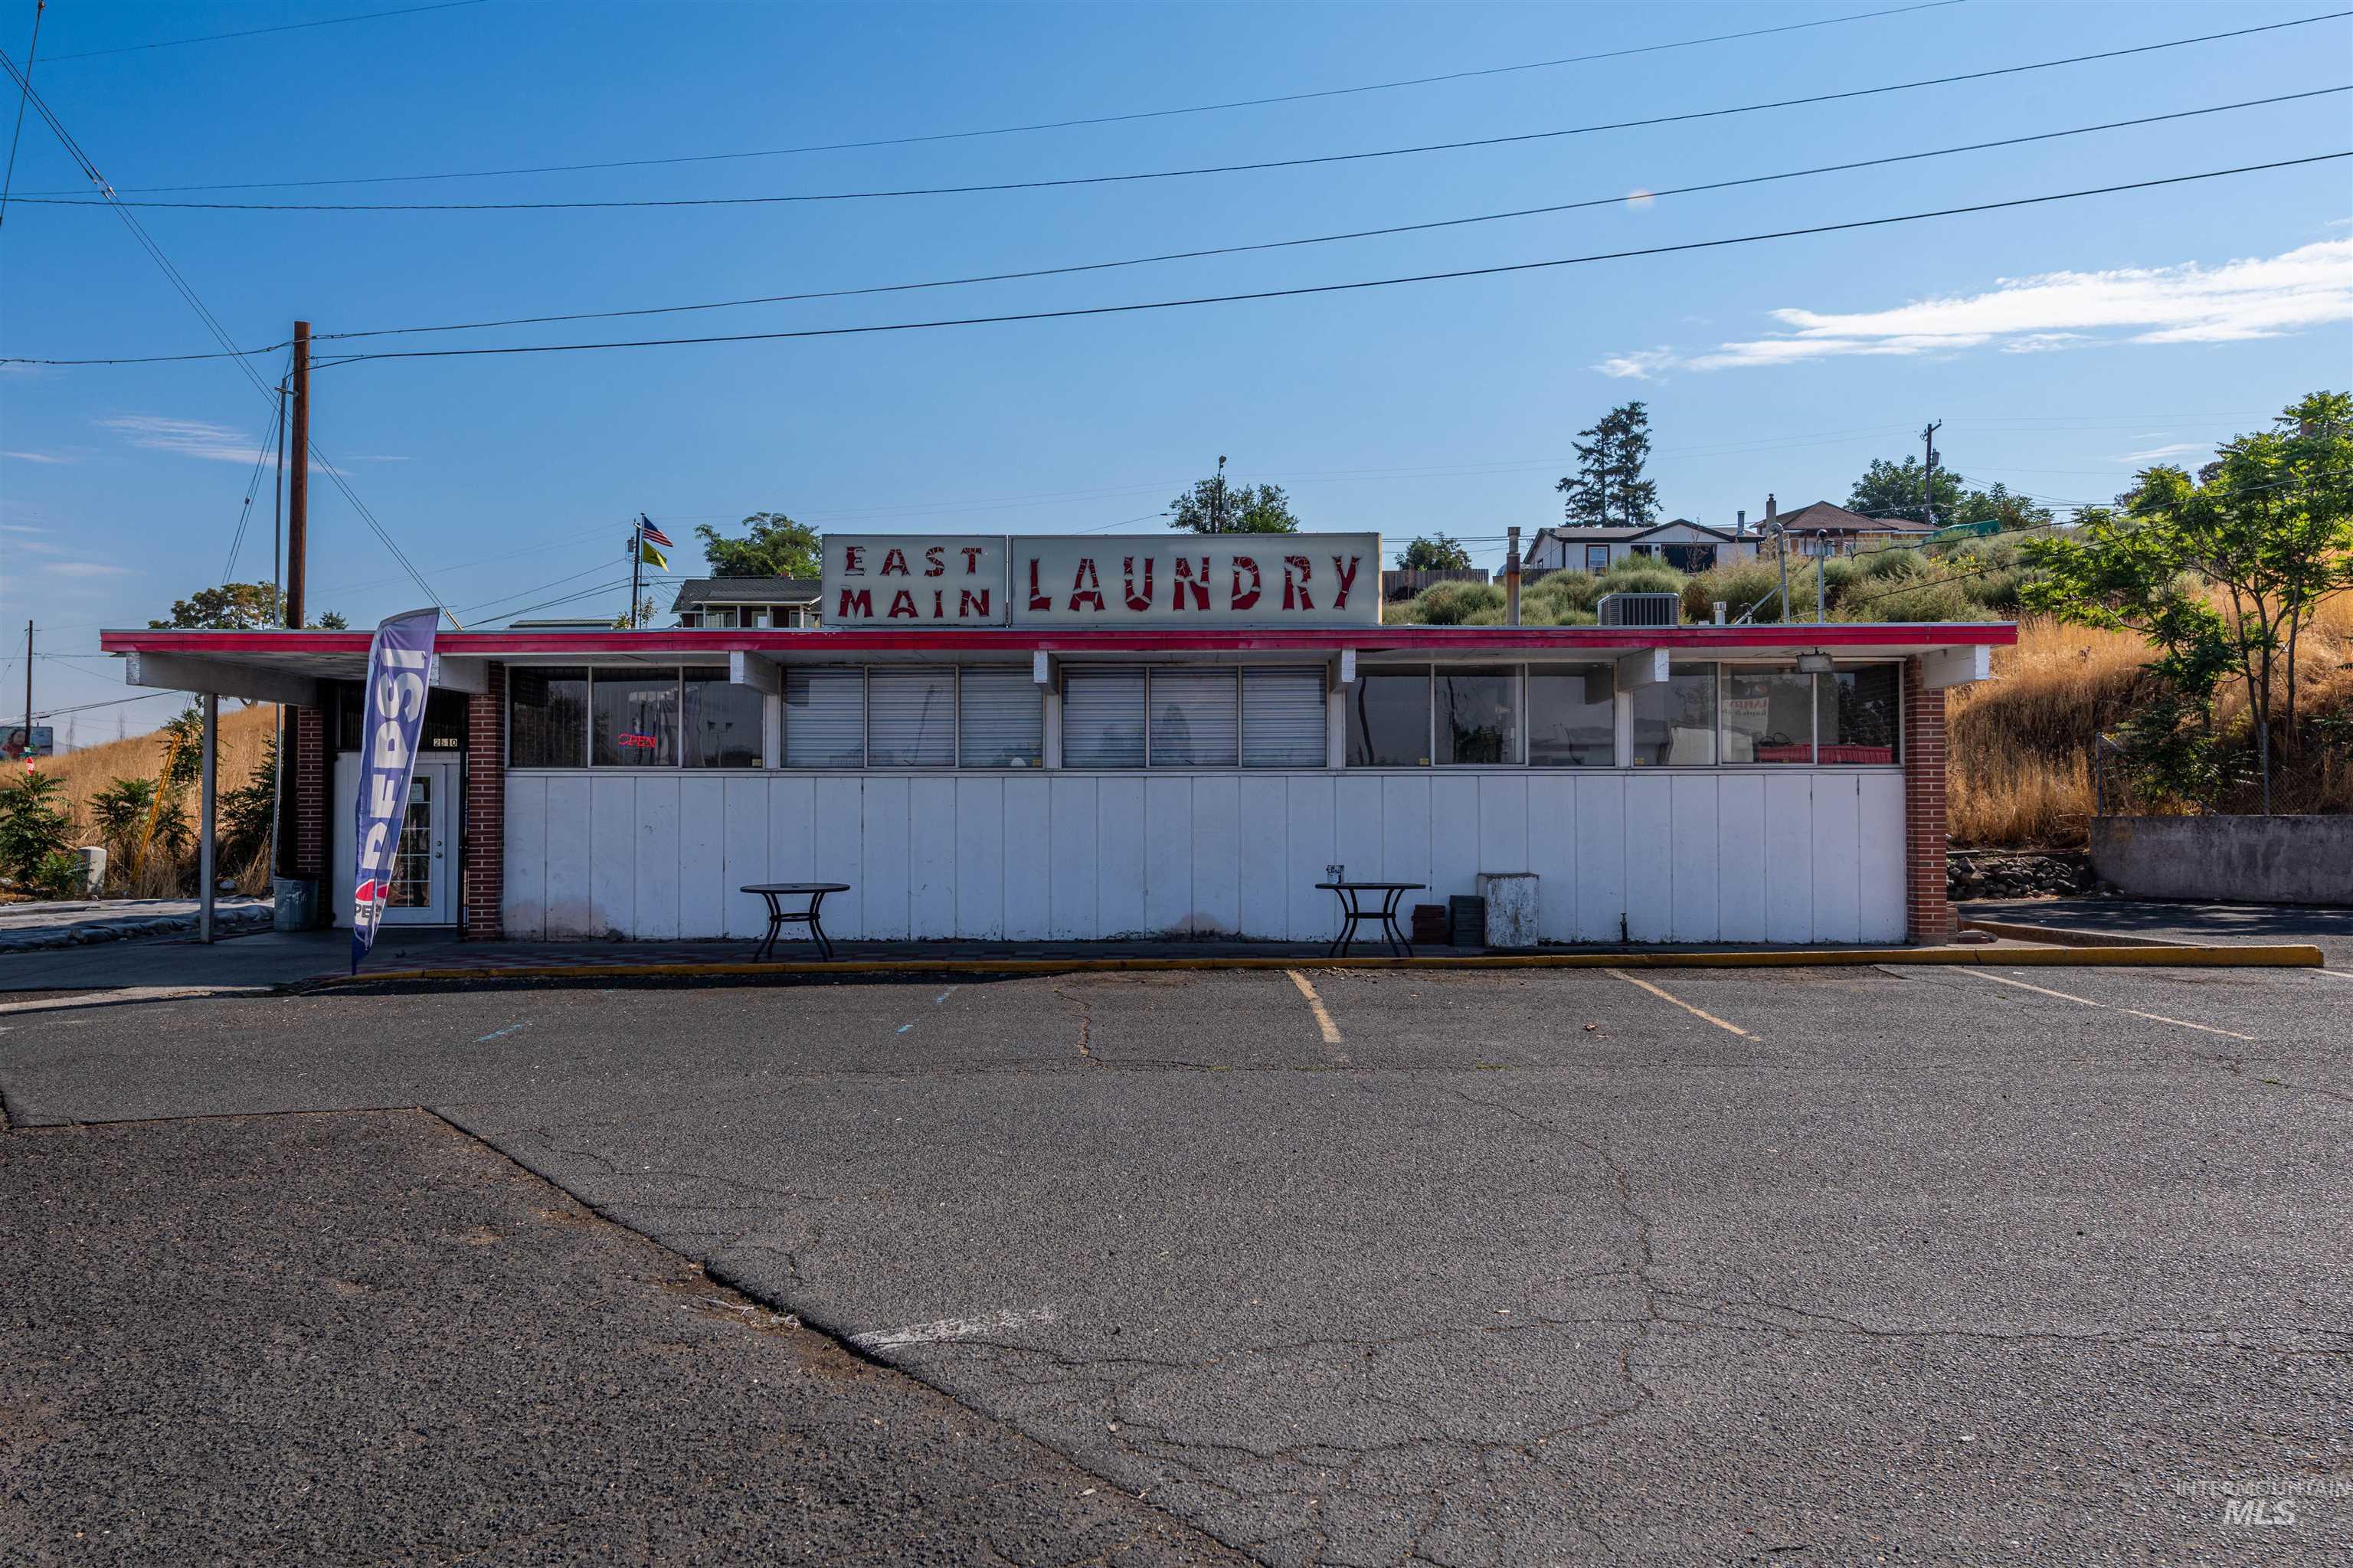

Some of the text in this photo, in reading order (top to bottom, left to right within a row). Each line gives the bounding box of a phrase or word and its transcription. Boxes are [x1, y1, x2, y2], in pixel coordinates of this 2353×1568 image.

[845, 546, 983, 577] EAST
[1029, 556, 1361, 611] LAUNDRY
[838, 588, 990, 618] MAIN
[618, 733, 656, 748] OPEN
